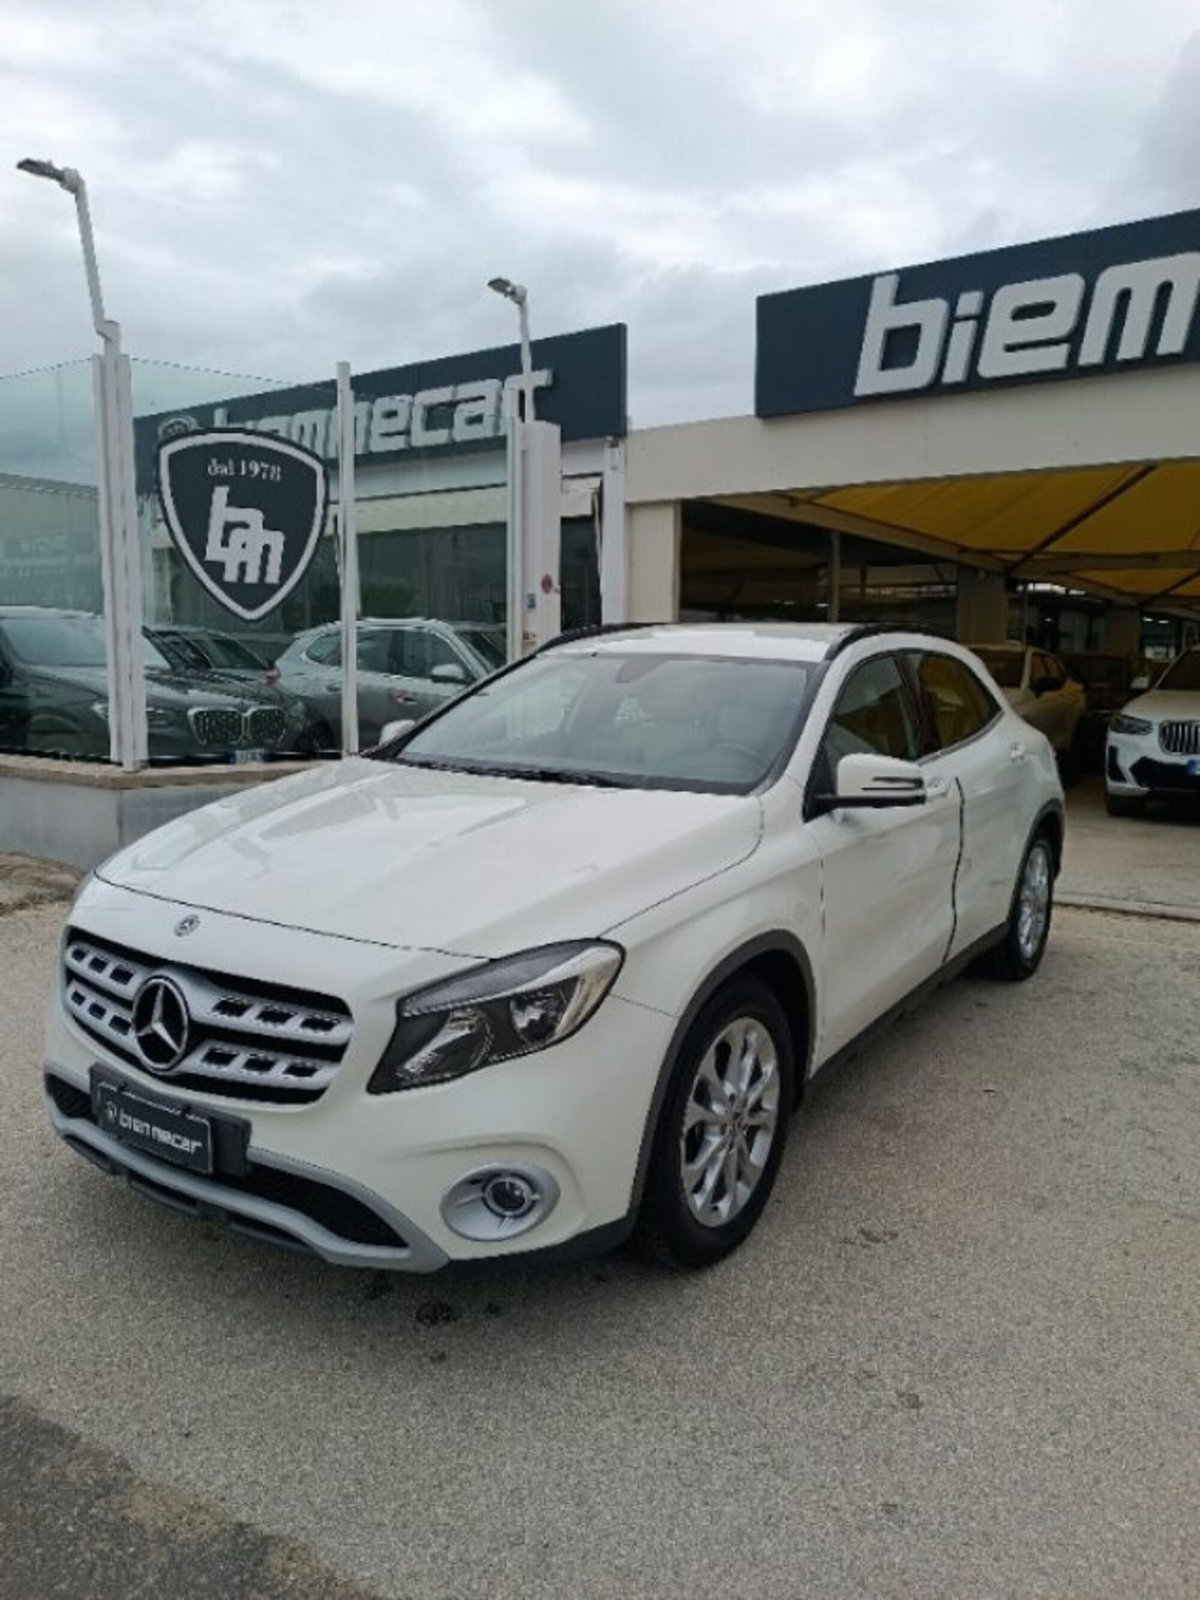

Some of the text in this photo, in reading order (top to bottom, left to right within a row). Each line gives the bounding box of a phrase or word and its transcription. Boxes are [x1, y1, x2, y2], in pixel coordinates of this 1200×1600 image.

[853, 251, 1200, 397] biem
[213, 369, 552, 460] mmecar
[207, 458, 282, 481] dal 1978
